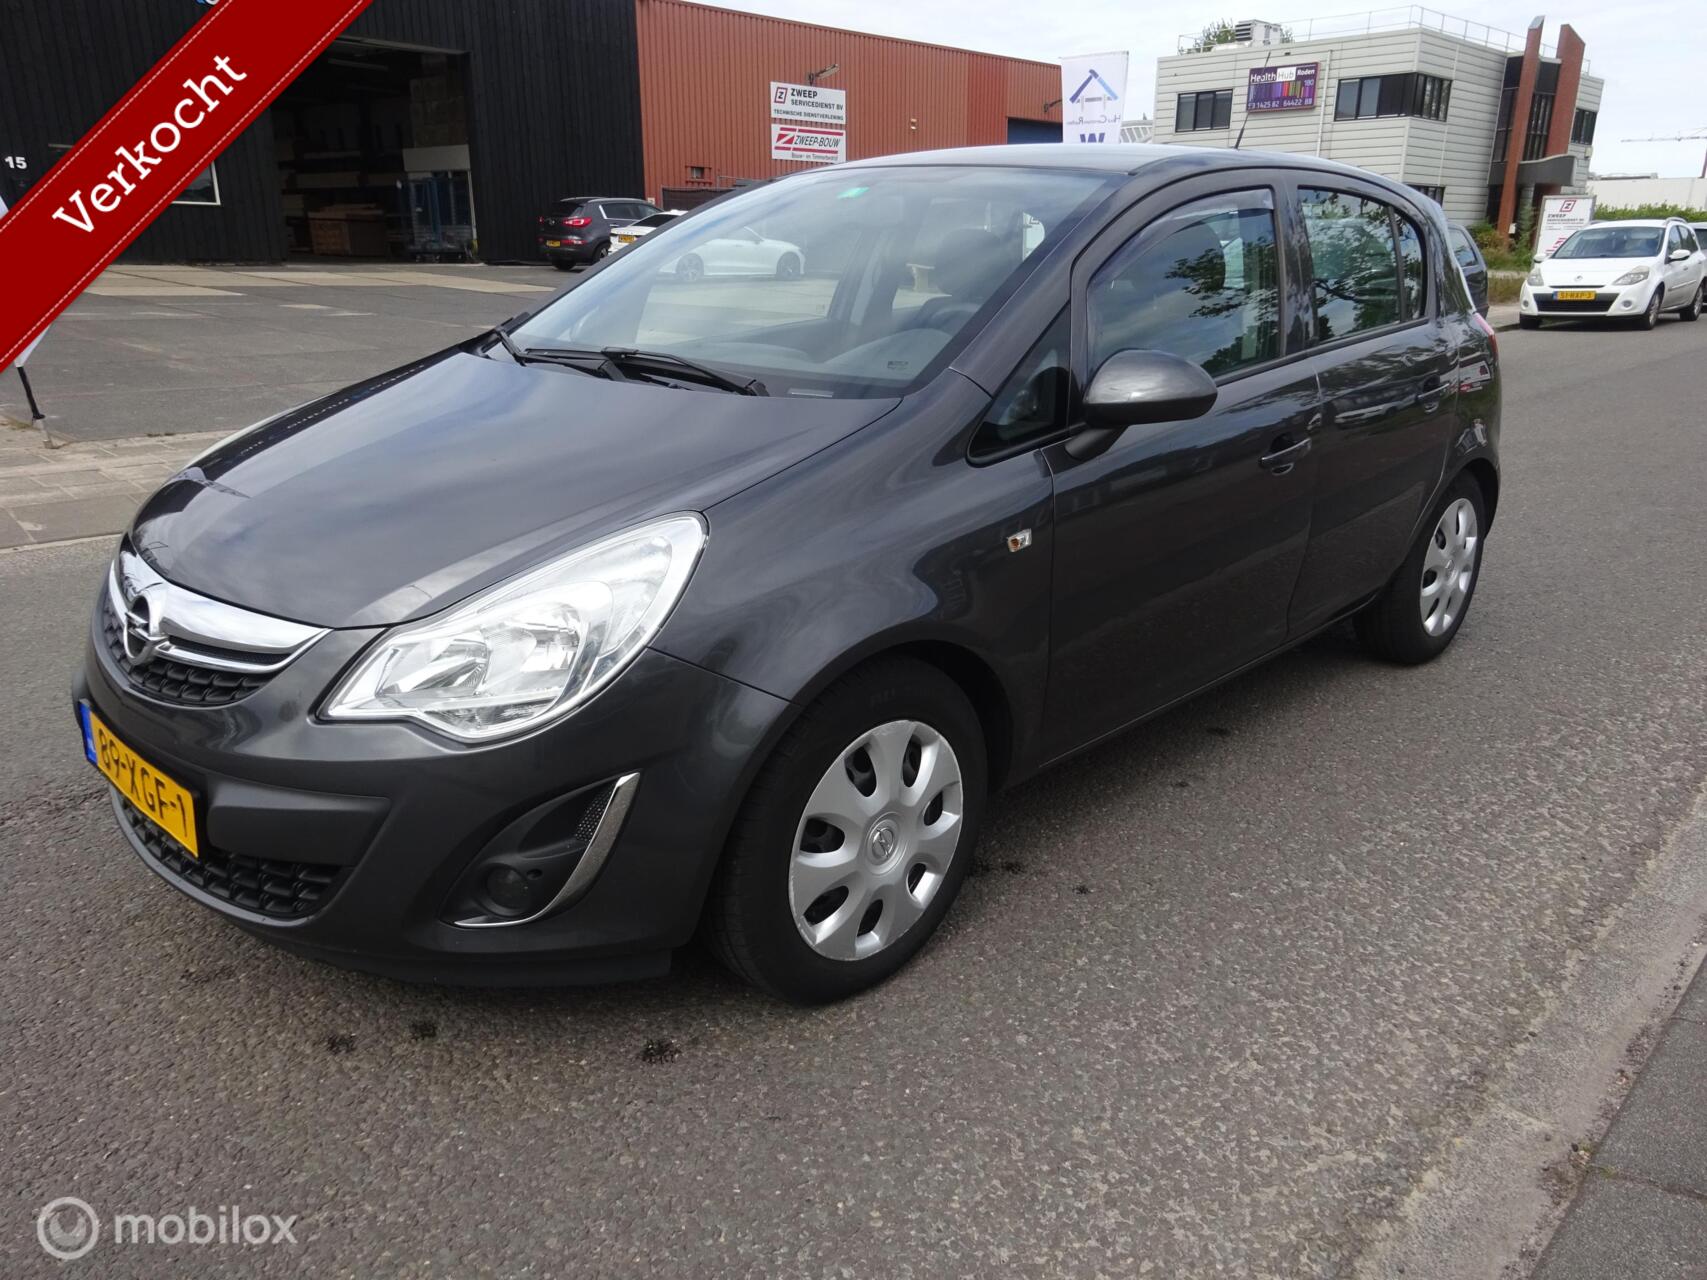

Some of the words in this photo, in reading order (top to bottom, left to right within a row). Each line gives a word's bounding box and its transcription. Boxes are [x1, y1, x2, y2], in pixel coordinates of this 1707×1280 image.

[1250, 72, 1277, 83] Health
[1278, 70, 1294, 80] Hub
[1297, 68, 1315, 76] Roden
[791, 88, 818, 98] ZWEEP
[791, 99, 835, 110] SERVICEDIENST
[773, 109, 802, 117] TECHNISCHE
[803, 112, 844, 121] DIENSTVERLENING
[794, 135, 841, 147] ZWEEP-BOUW
[4, 156, 28, 170] 15
[98, 727, 188, 838] 89-XGF-1
